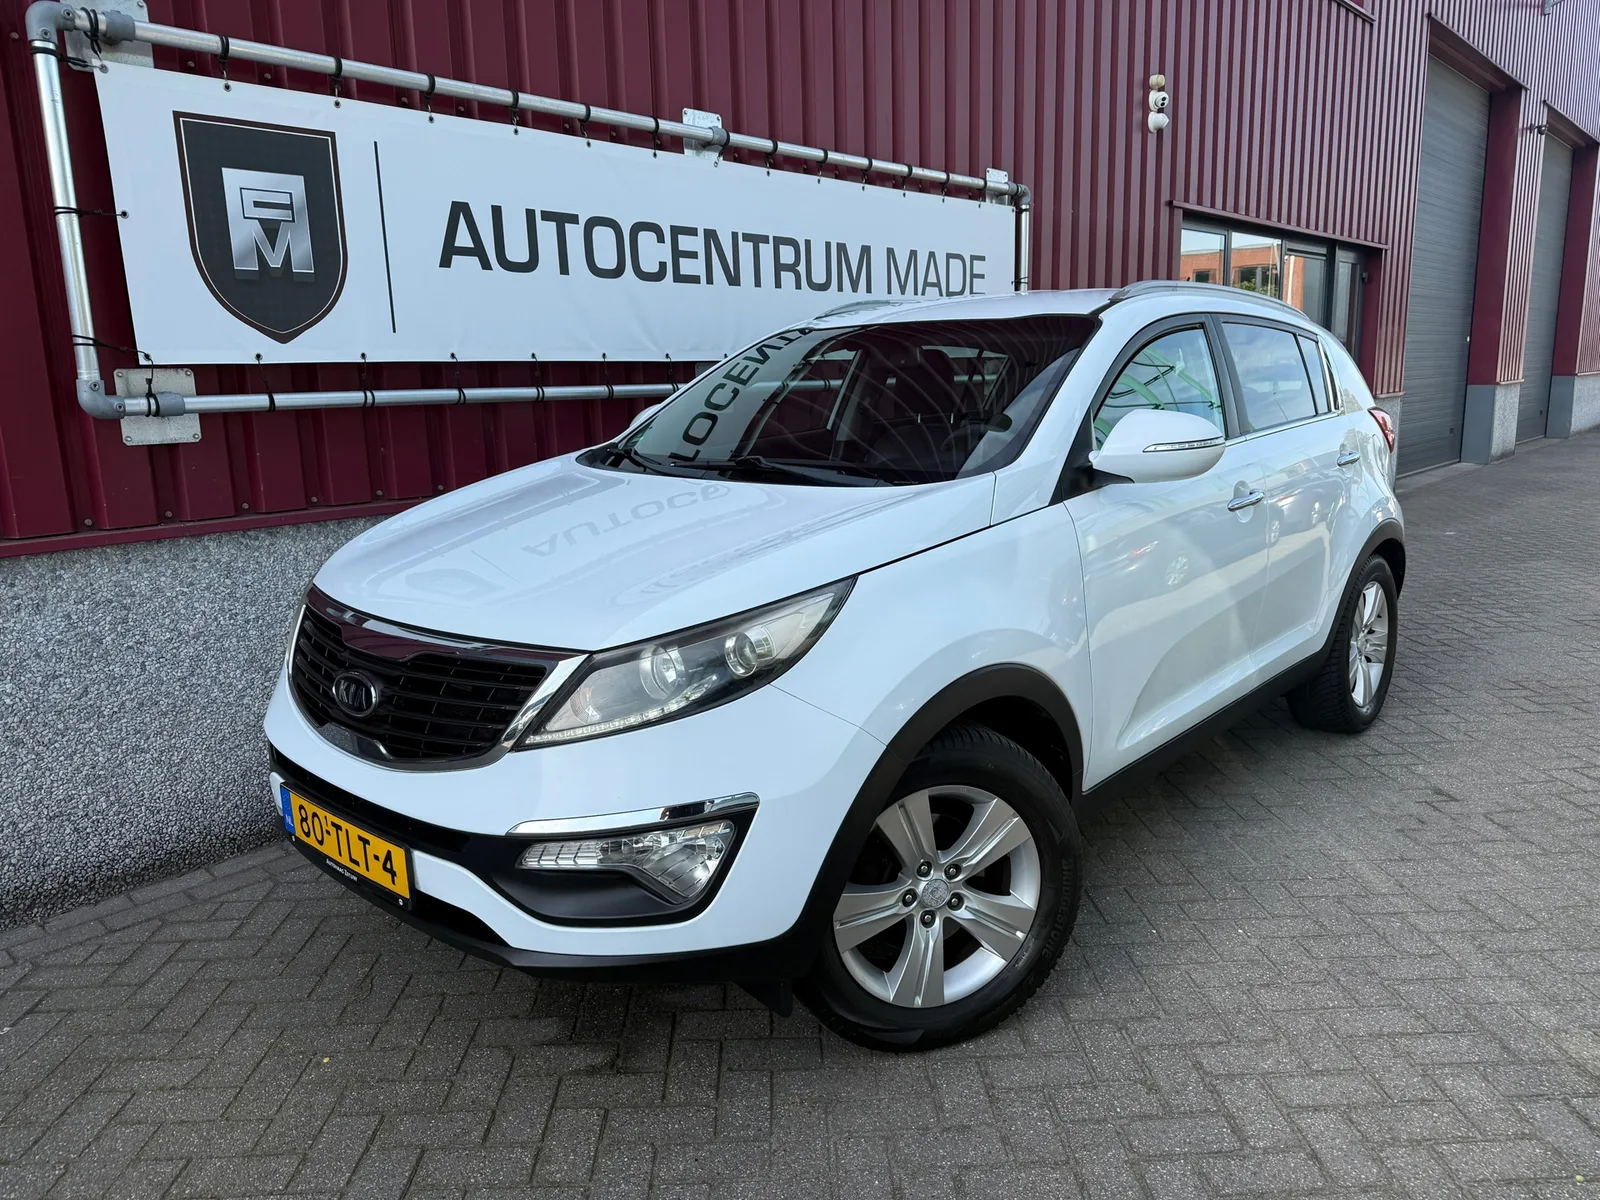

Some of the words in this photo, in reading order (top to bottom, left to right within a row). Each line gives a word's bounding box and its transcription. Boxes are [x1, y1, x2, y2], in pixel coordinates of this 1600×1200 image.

[439, 200, 872, 294] AUTOCENTRUM
[886, 246, 986, 297] MADE
[298, 804, 397, 886] 80-TLT-4
